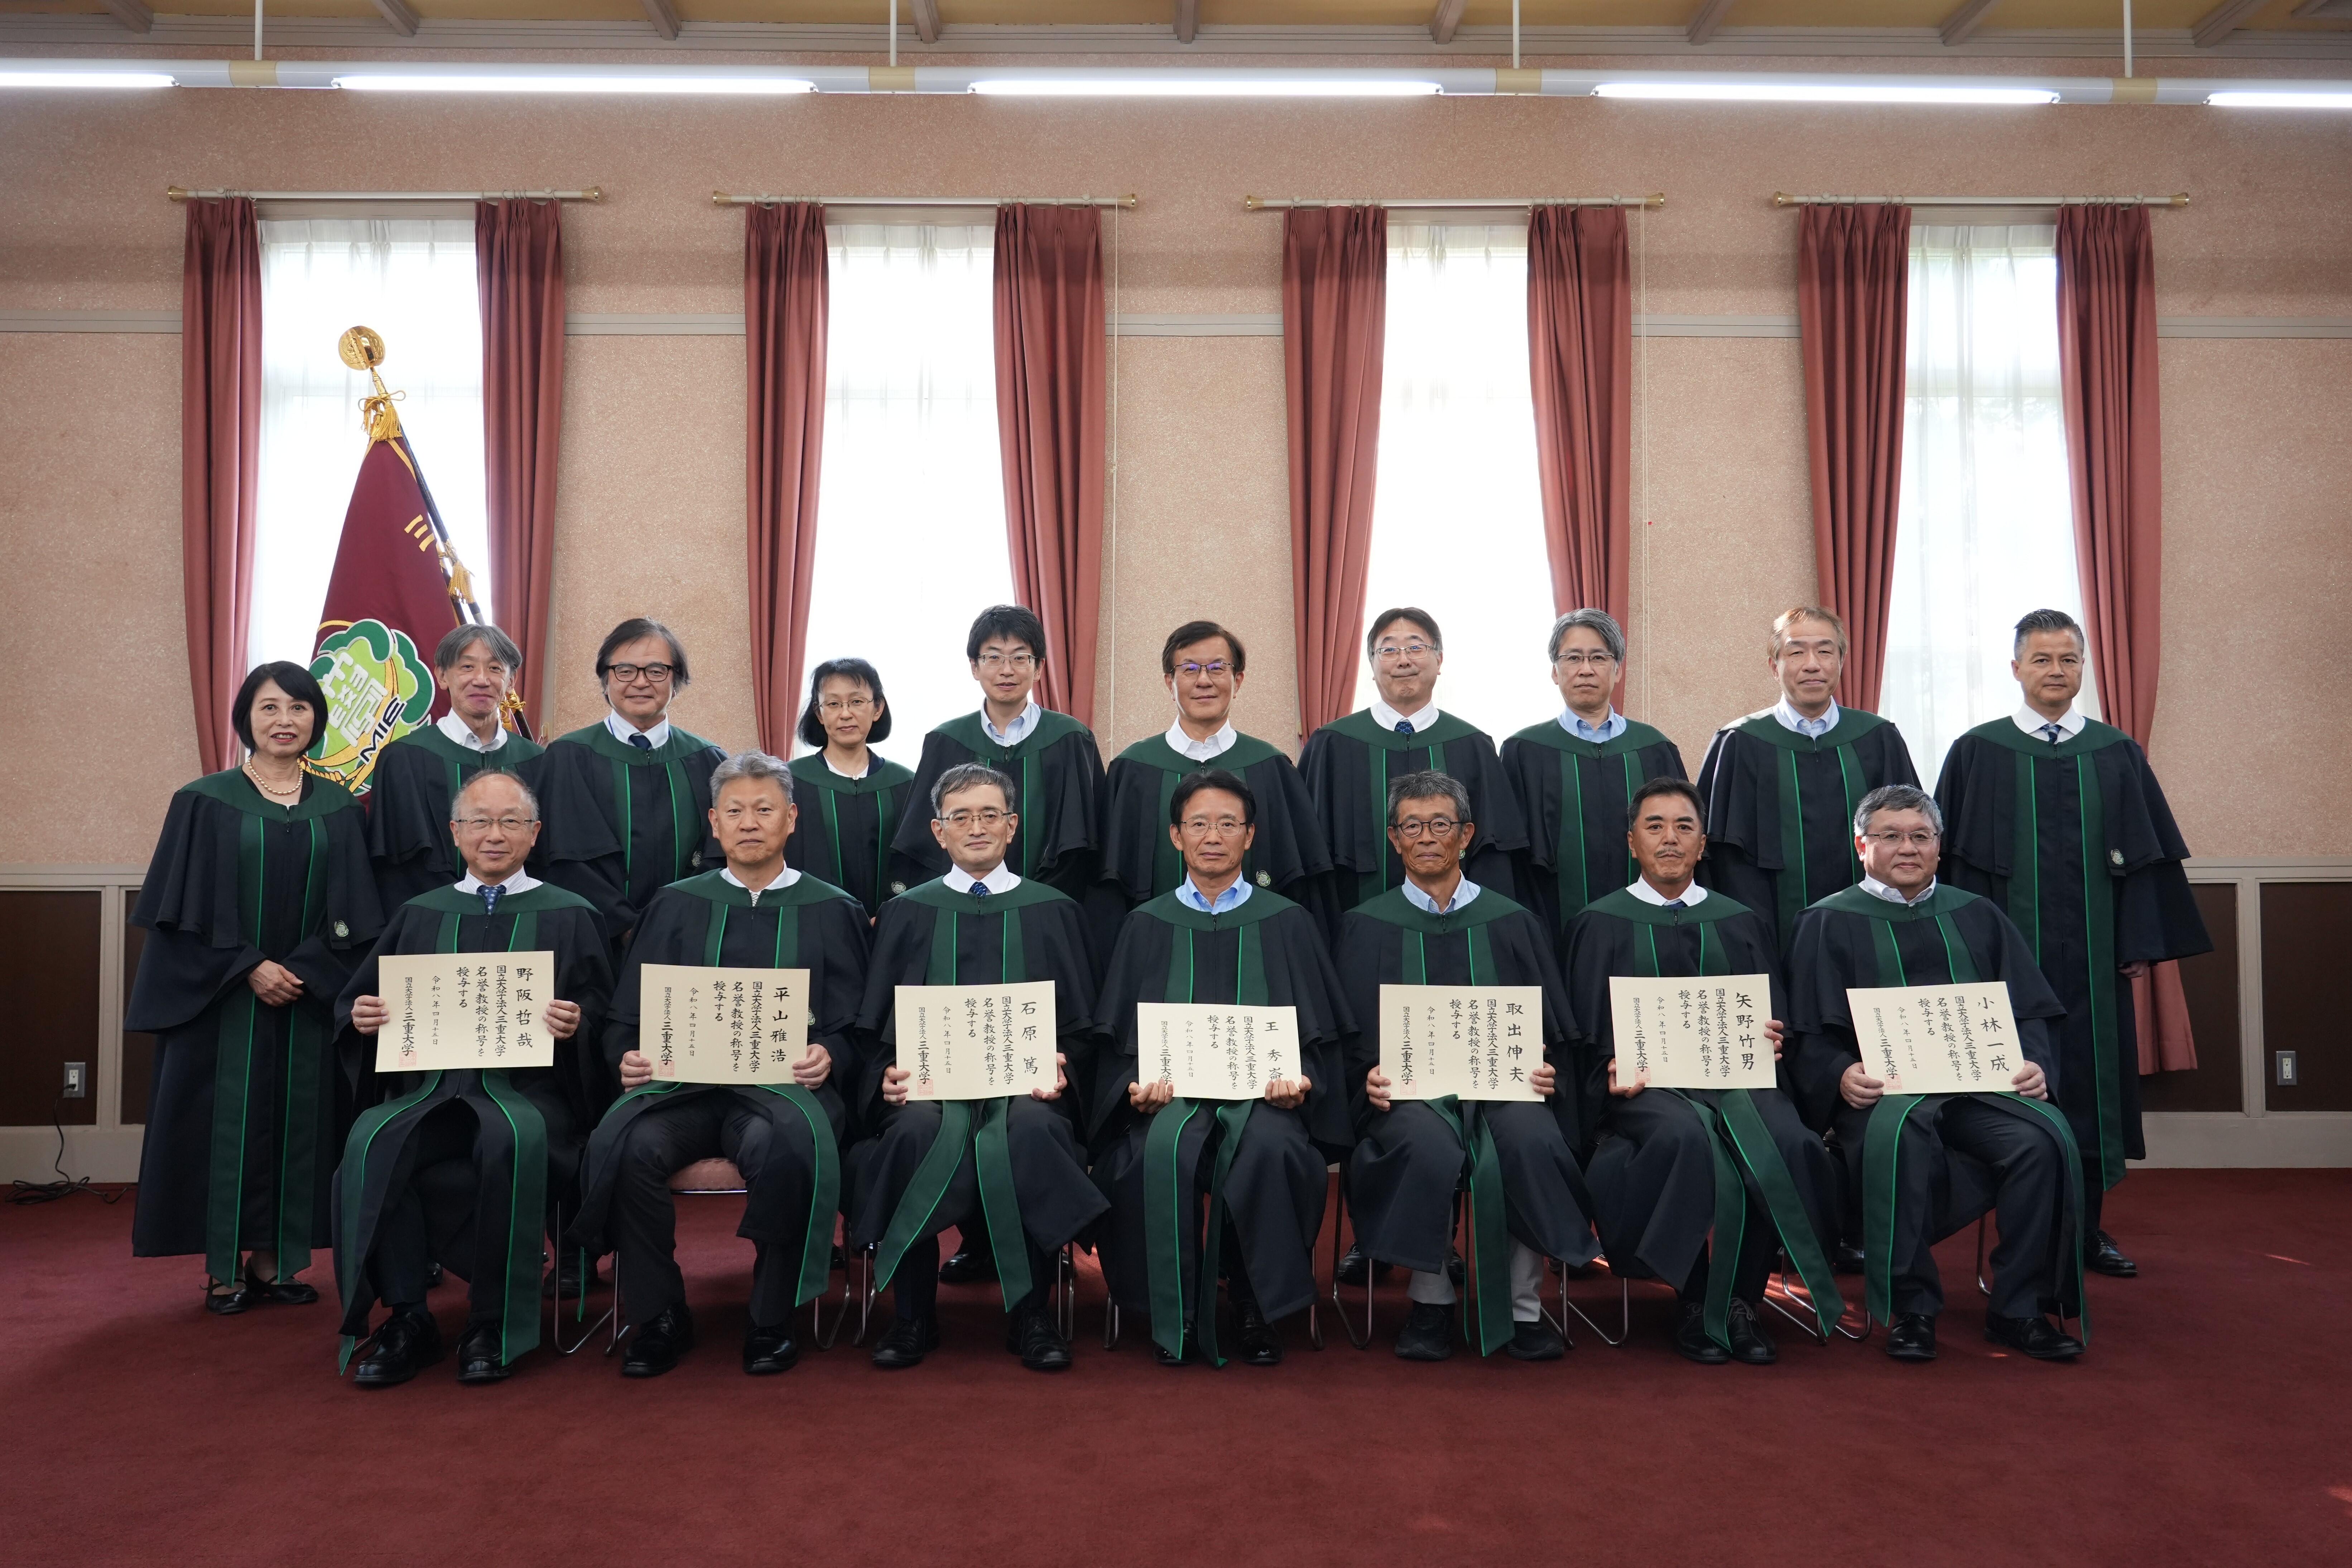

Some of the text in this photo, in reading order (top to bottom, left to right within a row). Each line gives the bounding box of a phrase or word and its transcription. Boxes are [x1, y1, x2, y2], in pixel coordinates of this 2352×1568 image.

[359, 696, 405, 764] MIE
[401, 977, 415, 1057] 国立大学法人三重大学
[431, 976, 441, 1045] 令和八年四月十五日
[456, 966, 471, 1008] 授与する
[475, 966, 490, 1057] 名誉教授の称号を
[495, 965, 508, 1057] 国立大学法人三重大学
[515, 968, 534, 1048] 野阪哲哉
[688, 987, 699, 1057] 令和八年四月十五日
[713, 981, 727, 1021] 授与する
[770, 987, 790, 1062] 平山雅浩
[964, 998, 978, 1038] 授与する
[1449, 999, 1463, 1039] 授与する
[1678, 990, 1692, 1029] 授与する
[1918, 998, 1935, 1035] 授与する
[661, 987, 673, 1066] 国立大学法人三重大学
[730, 981, 745, 1072] 名誉教授の称号を
[749, 981, 763, 1073] 国立大学法人三重大学
[918, 1007, 930, 1084] 国立大学法人三重大学
[943, 1006, 952, 1074] 令和八年四月十五日
[982, 997, 997, 1086] 名誉教授の称号を
[1001, 996, 1014, 1084] 国立大学法人三重大学
[1020, 1001, 1038, 1074] 石原篤
[1207, 1015, 1221, 1049] 授与する
[1225, 1015, 1239, 1090] 名誉教授の称号を
[1244, 1016, 1257, 1089] 国立大学法人三重大学
[1401, 1006, 1413, 1085] 国立大学法人三重大学
[1427, 1006, 1435, 1075] 令和八年四月十五日
[1467, 999, 1481, 1088] 名誉教授の称号を
[1486, 999, 1499, 1090] 国立大学法人三重大学
[1505, 1003, 1524, 1082] 取出伸夫
[1633, 997, 1648, 1072] 国立大学法人三重大学
[1656, 997, 1668, 1062] 令和八年四月十五日
[1696, 989, 1712, 1077] 名誉教授の称号を
[1716, 988, 1731, 1077] 国立大学法人三重大学
[1736, 992, 1755, 1070] 矢野竹男
[1873, 1007, 1898, 1079] 国立大学法人三重大学
[1898, 1007, 1917, 1069] 令和八年四月十五日
[1937, 997, 1962, 1081] 名誉教授の称号を
[1954, 996, 1982, 1081] 国立大学法人三重大学
[1978, 997, 2009, 1072] 小林一成
